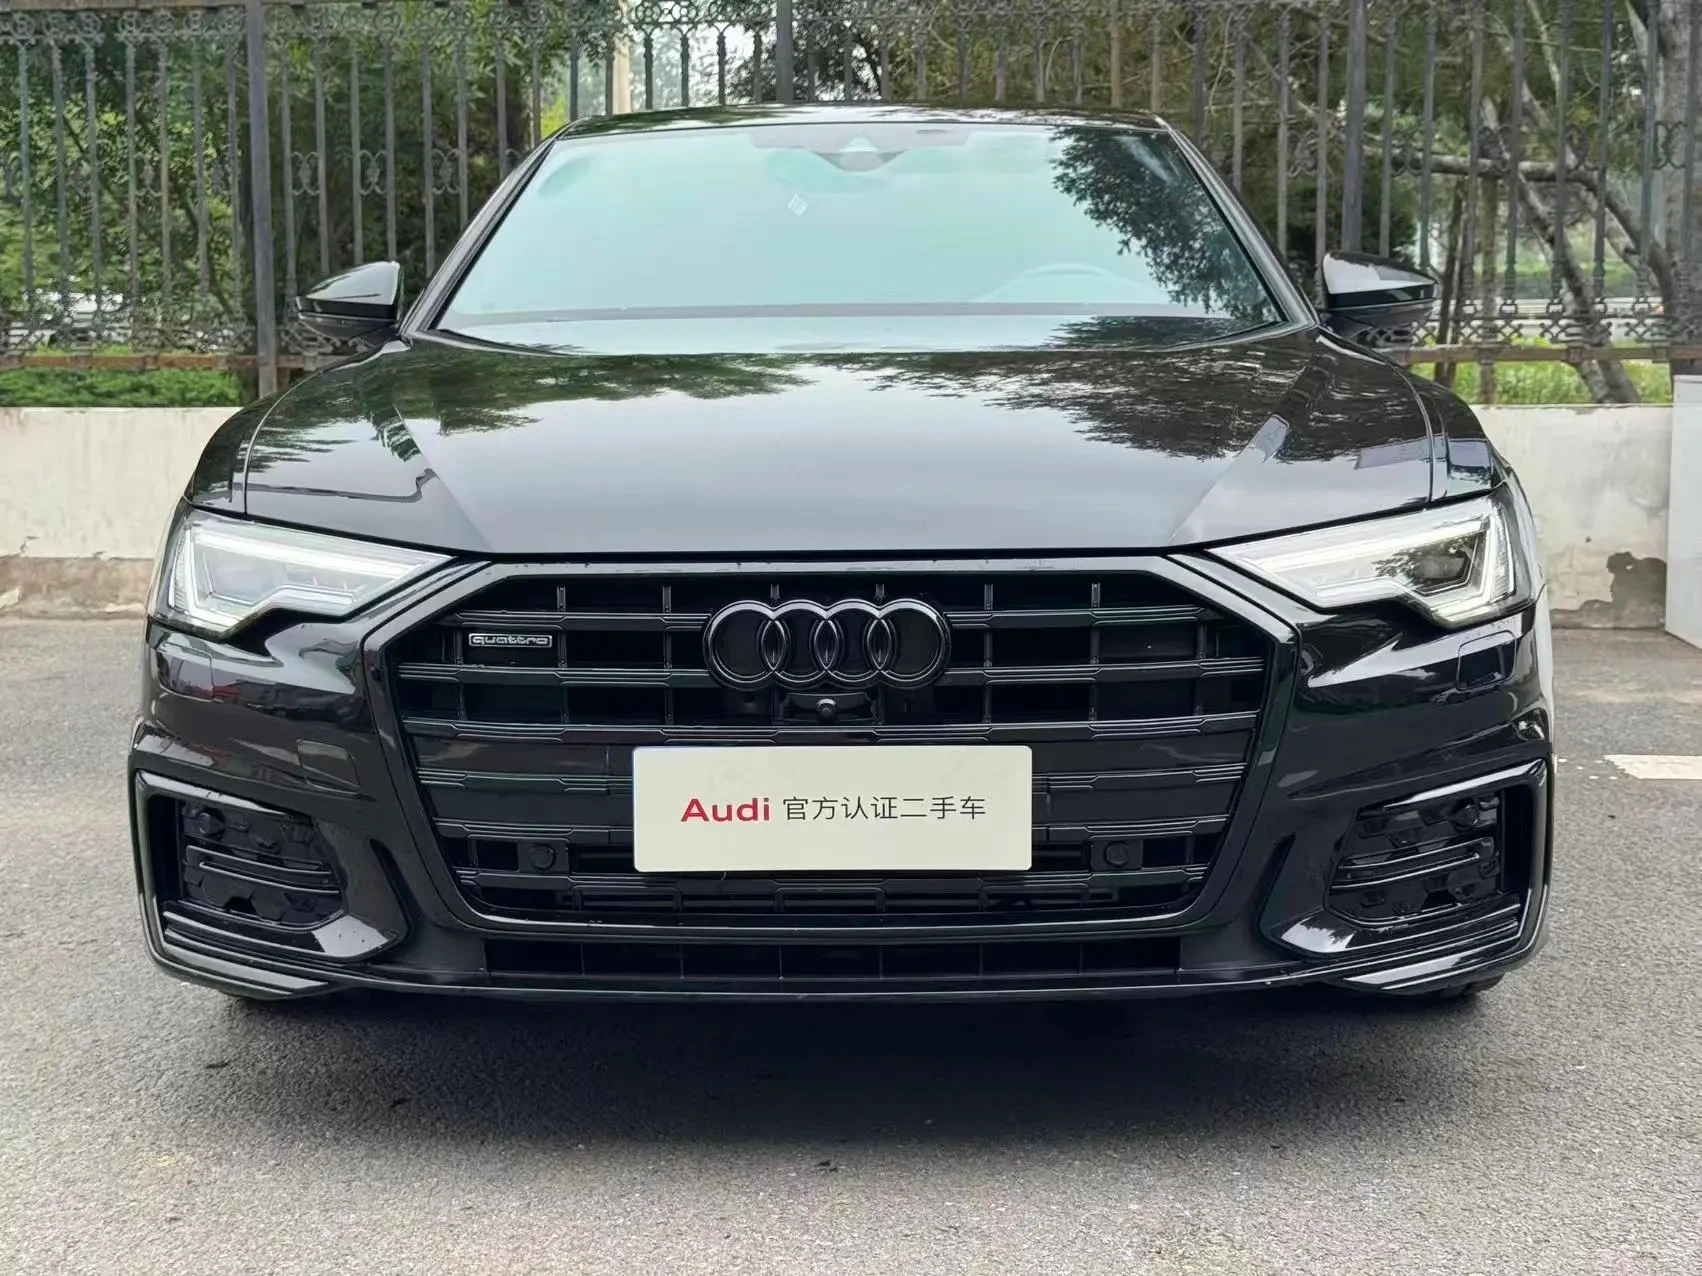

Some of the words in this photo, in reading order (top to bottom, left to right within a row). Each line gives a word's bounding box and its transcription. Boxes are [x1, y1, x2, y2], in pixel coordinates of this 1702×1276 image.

[472, 636, 549, 645] quattro
[681, 798, 770, 822] Audi
[783, 796, 986, 821] 官方认证二手车
